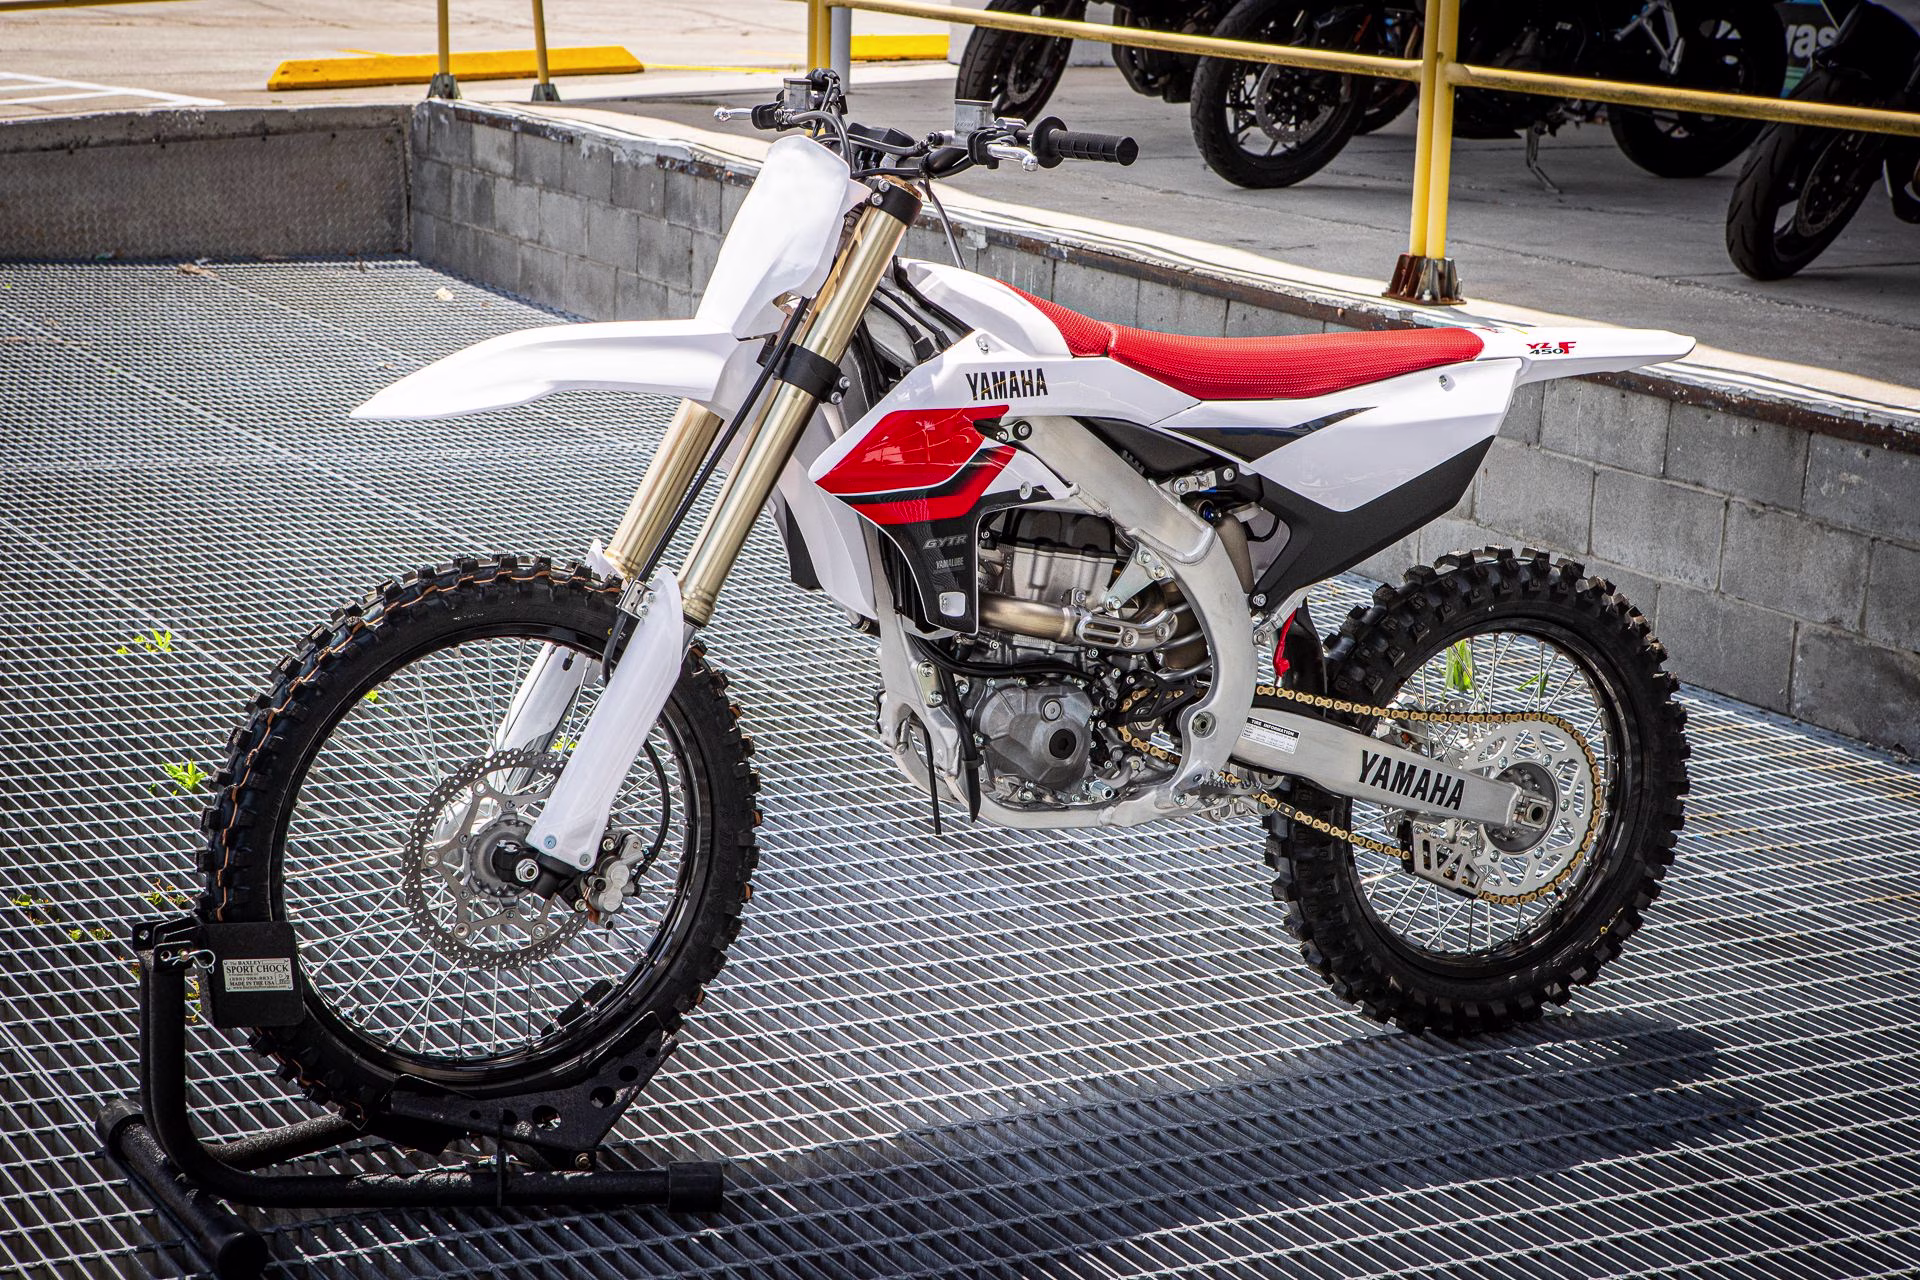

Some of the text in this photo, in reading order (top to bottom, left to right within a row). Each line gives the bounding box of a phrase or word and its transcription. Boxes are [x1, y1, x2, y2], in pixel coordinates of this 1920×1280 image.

[965, 368, 1048, 401] YAMAHA
[923, 534, 968, 549] GYTR
[1263, 723, 1295, 736] INFORMATION
[1358, 750, 1465, 810] YAMAHA
[226, 964, 289, 974] SPORT CHOCK
